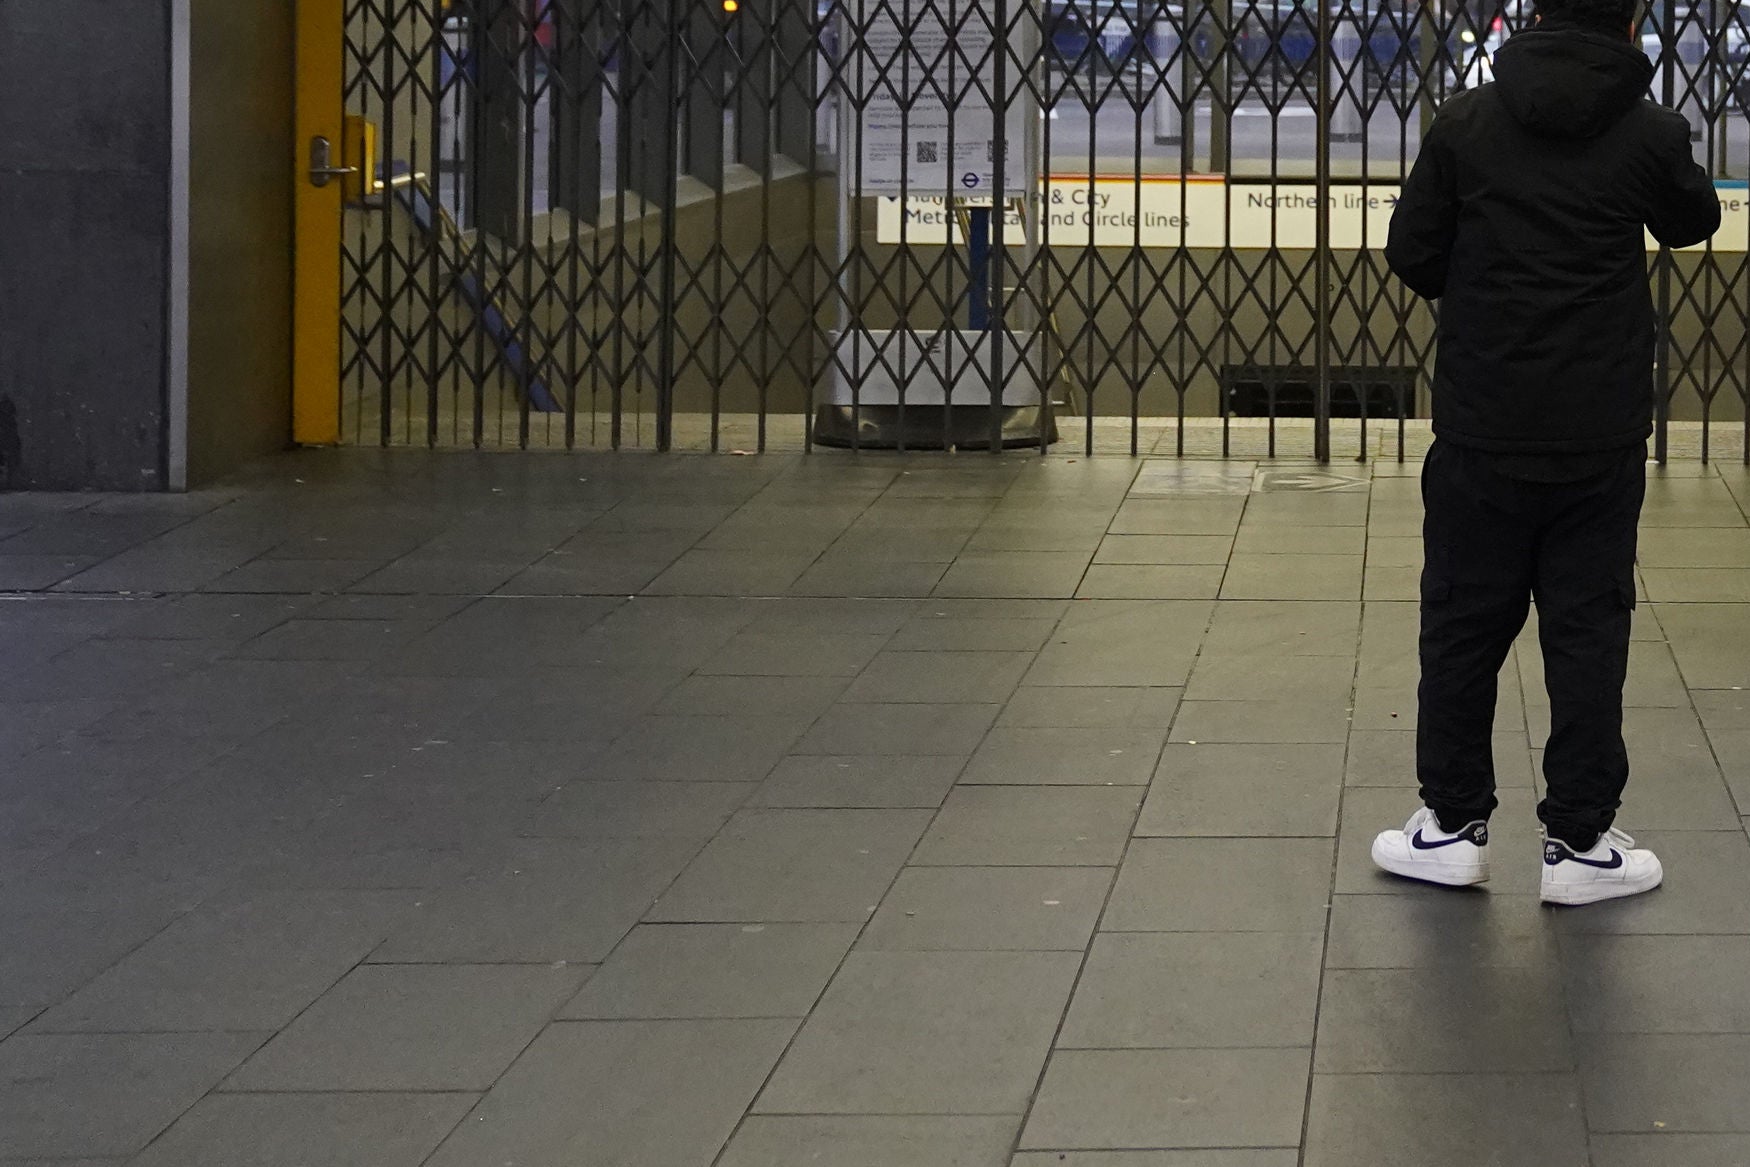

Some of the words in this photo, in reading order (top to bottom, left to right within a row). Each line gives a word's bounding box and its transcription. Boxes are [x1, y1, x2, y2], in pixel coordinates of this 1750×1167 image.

[1051, 190, 1065, 205] &
[1071, 189, 1111, 208] Cty
[1248, 193, 1337, 209] Northen
[1344, 193, 1379, 209] line
[1145, 211, 1191, 228] lines
